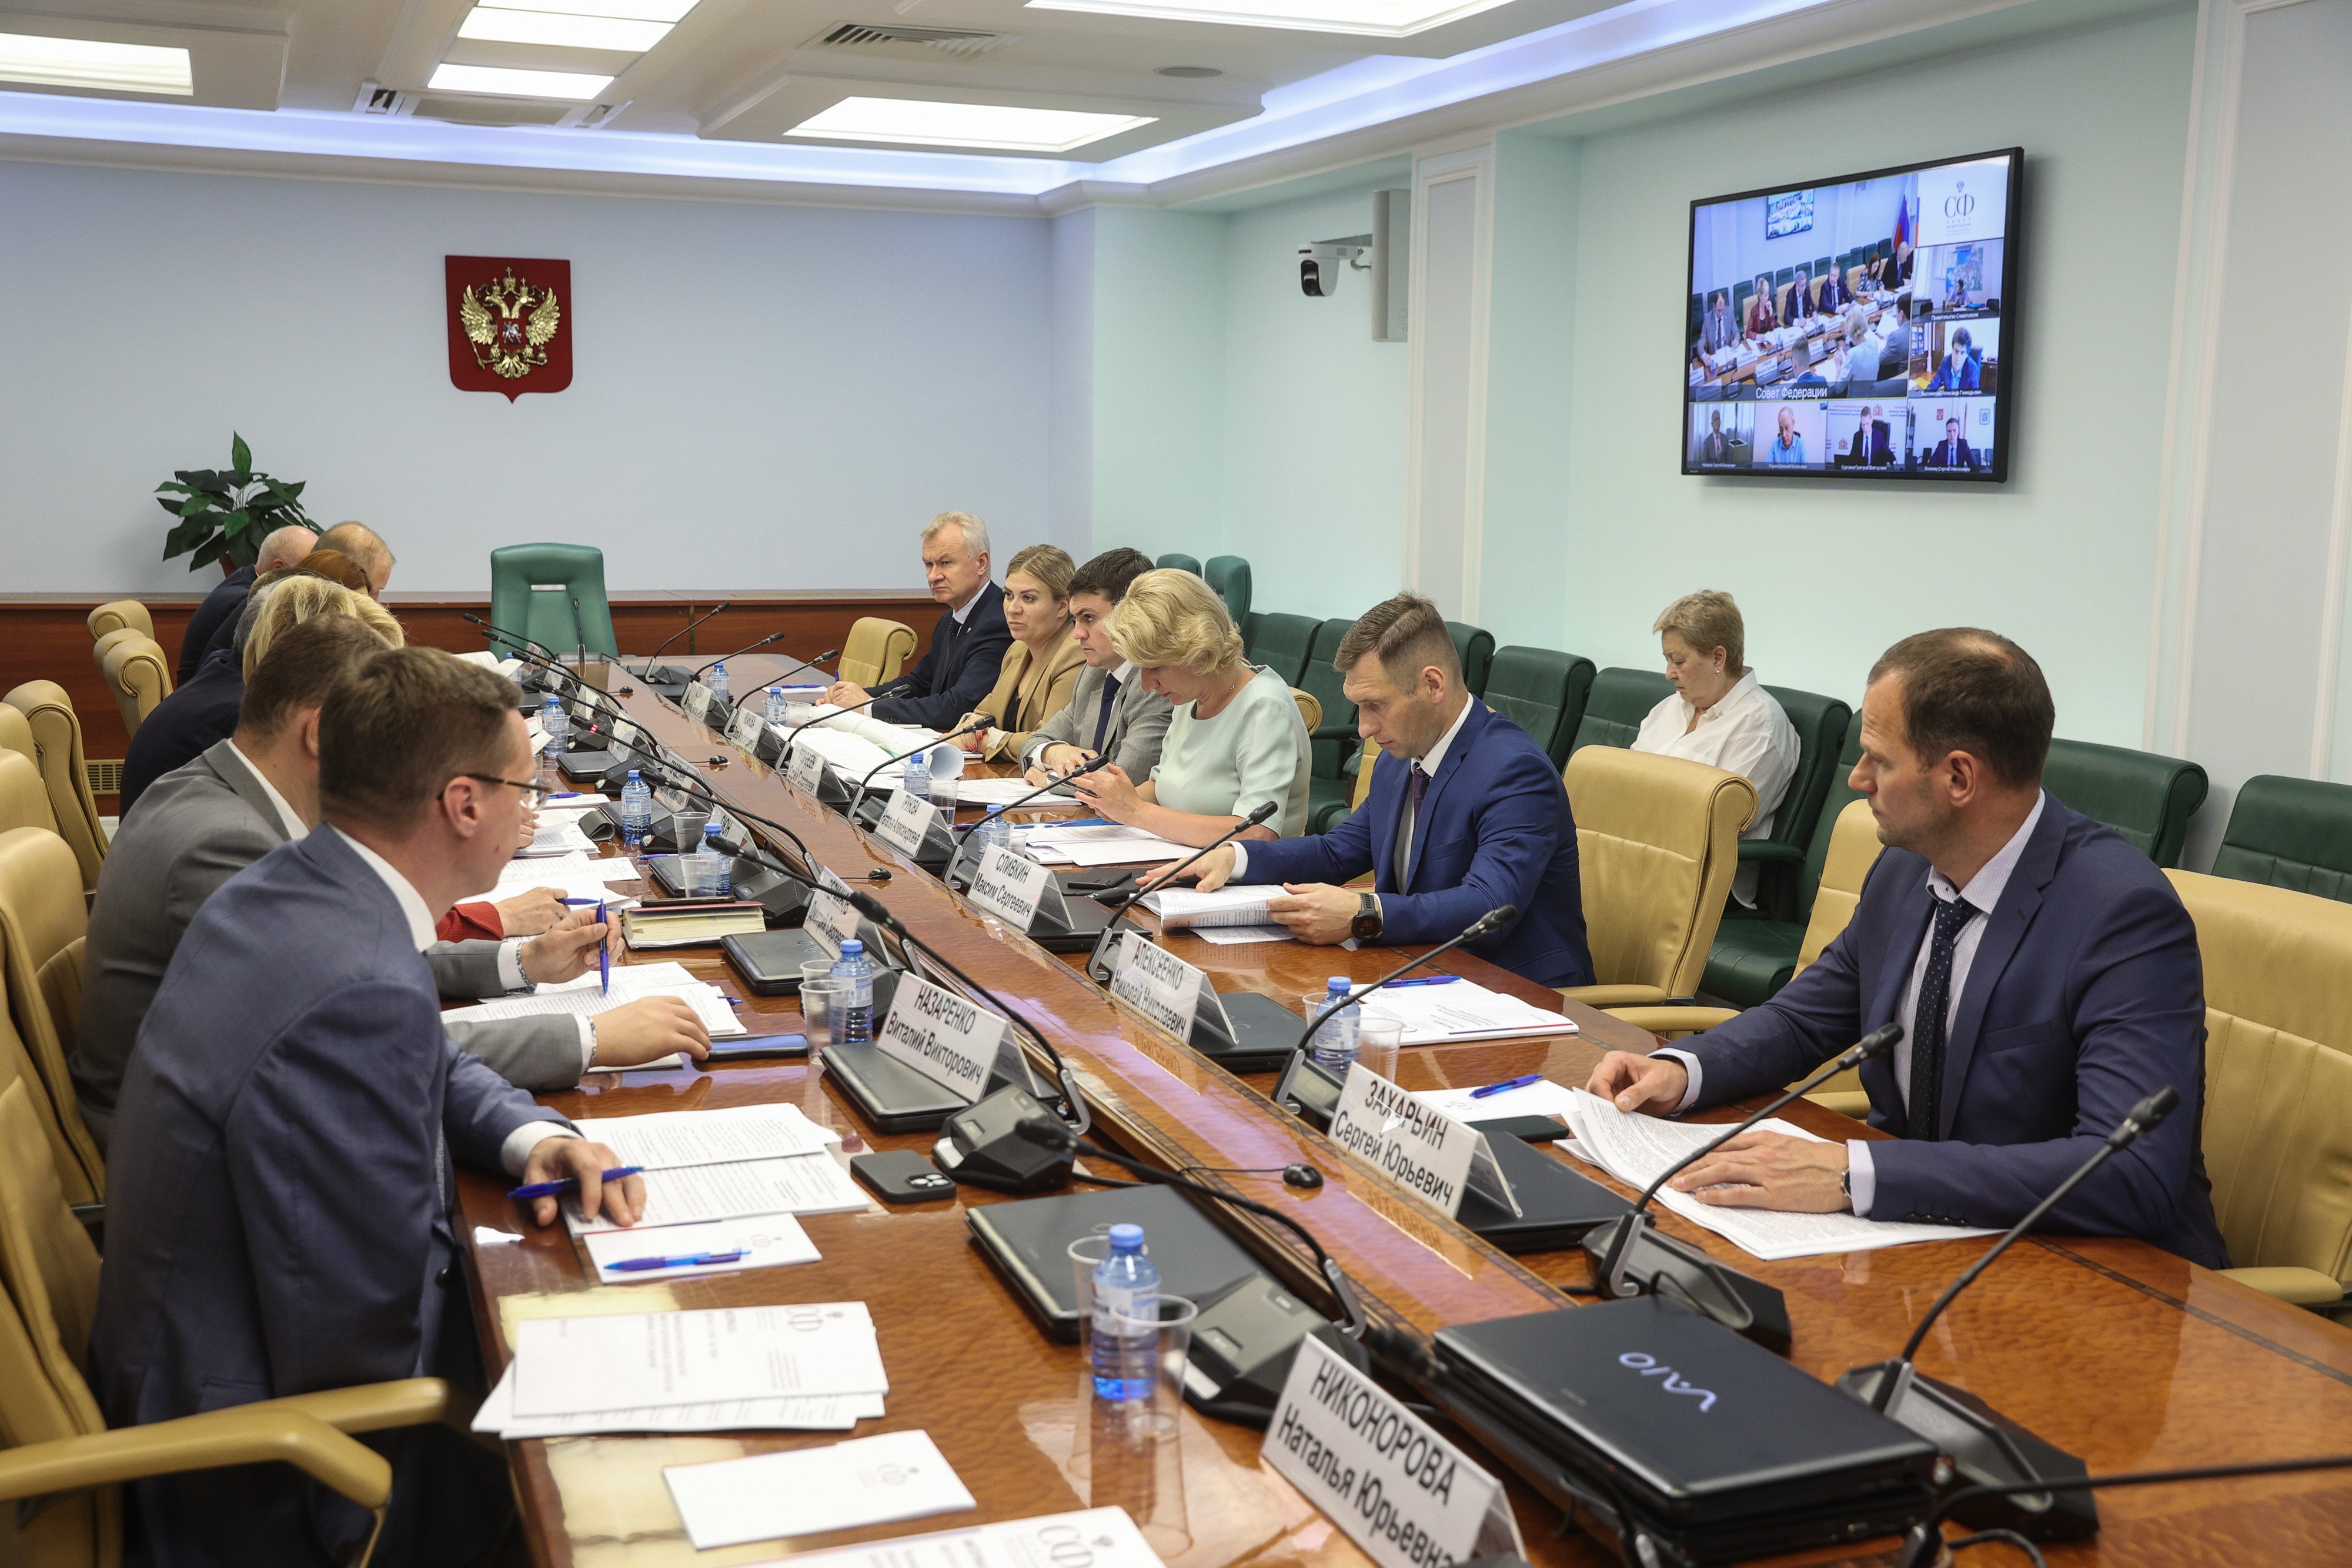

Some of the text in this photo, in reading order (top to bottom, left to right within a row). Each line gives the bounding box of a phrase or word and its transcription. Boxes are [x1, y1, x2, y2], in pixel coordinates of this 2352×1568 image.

[1945, 194, 1975, 218] СФ
[1755, 386, 1828, 400] Совет Федерации
[973, 873, 1033, 918] Максим Сергеевич
[995, 853, 1031, 884] СЛИВКИН
[1132, 941, 1184, 991] АЛЕКСЕЕНКО
[914, 985, 976, 1035] НАЗАРЕНКО
[1113, 969, 1187, 1038] Николай Николаевич
[886, 1011, 984, 1085] Виталий Викторович
[1365, 1080, 1449, 1150] ЗАХАРЬИН
[1335, 1110, 1454, 1206] Сергей Юрьевич
[1618, 1352, 1718, 1412] VAIO
[1277, 1403, 1357, 1500] Наталья
[1310, 1359, 1457, 1507] НИКОНОРОВА
